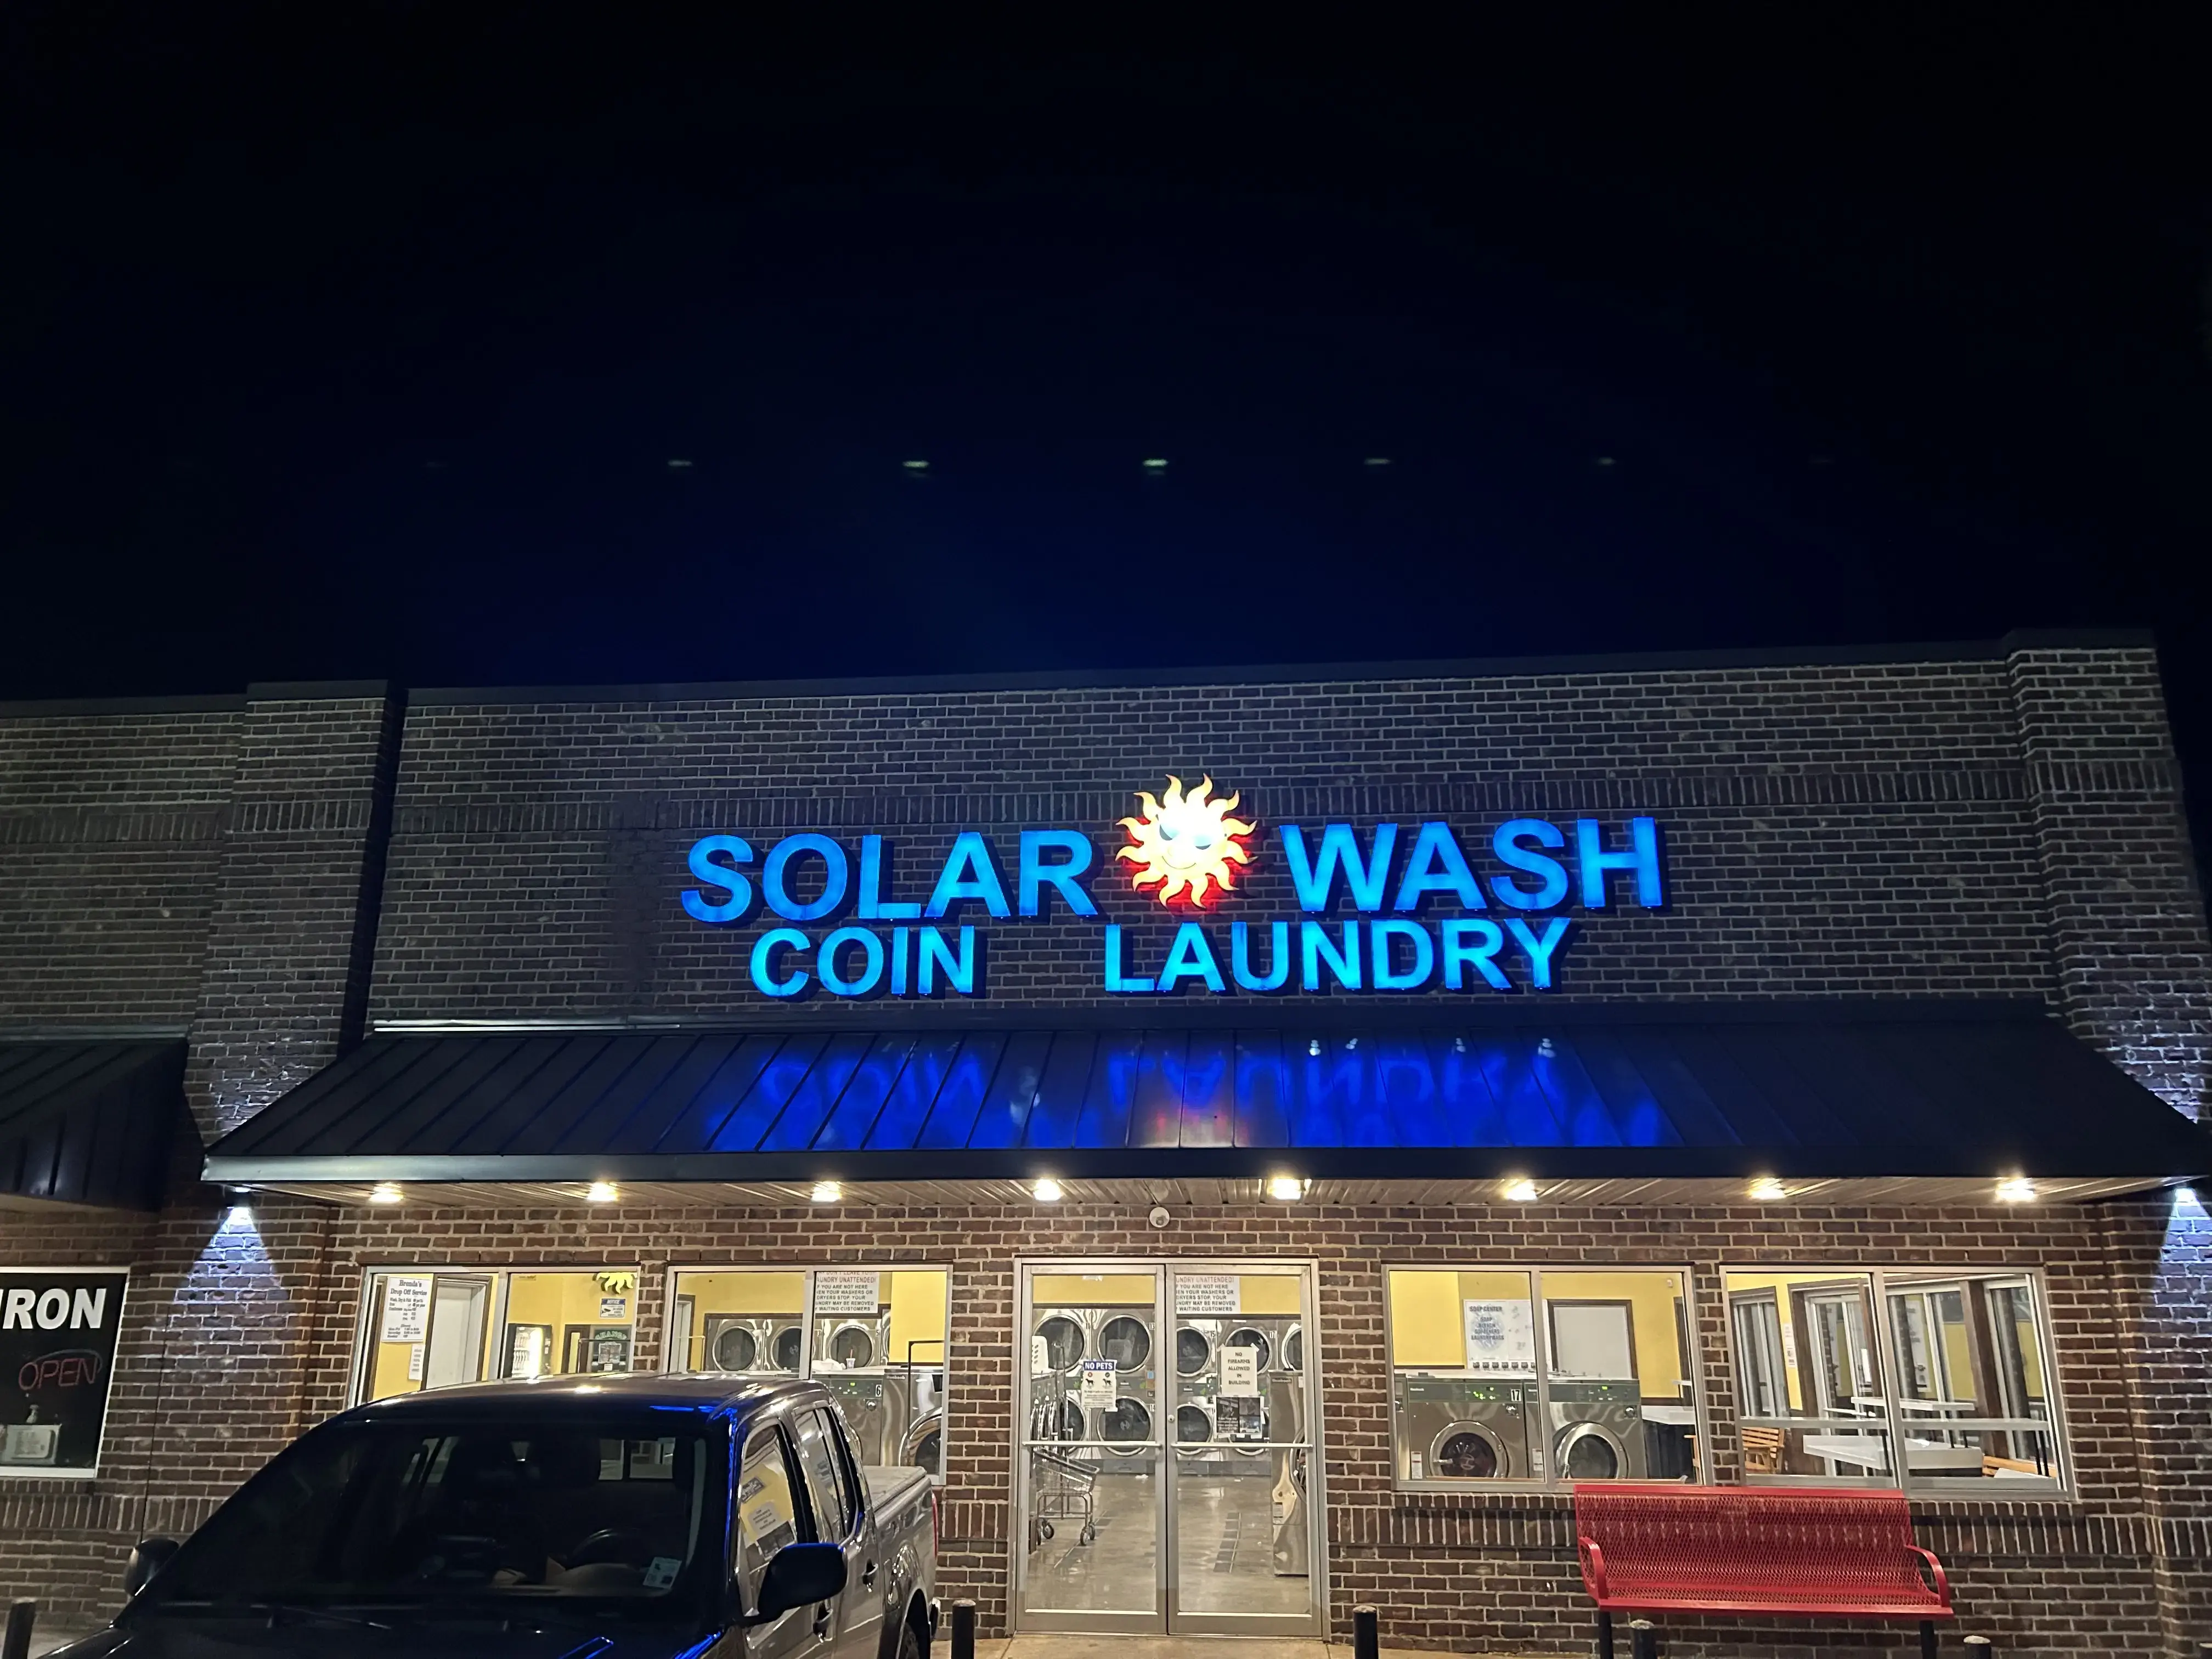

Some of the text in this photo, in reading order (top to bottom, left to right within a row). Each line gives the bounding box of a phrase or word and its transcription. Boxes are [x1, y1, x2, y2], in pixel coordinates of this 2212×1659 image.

[680, 816, 1663, 923] SOLAR WASH
[749, 917, 1571, 996] COIN LAUNDRY
[0, 1288, 107, 1329] RON
[18, 1358, 98, 1390] OPEN
[876, 1385, 881, 1395] 6
[1511, 1390, 1520, 1401] 17
